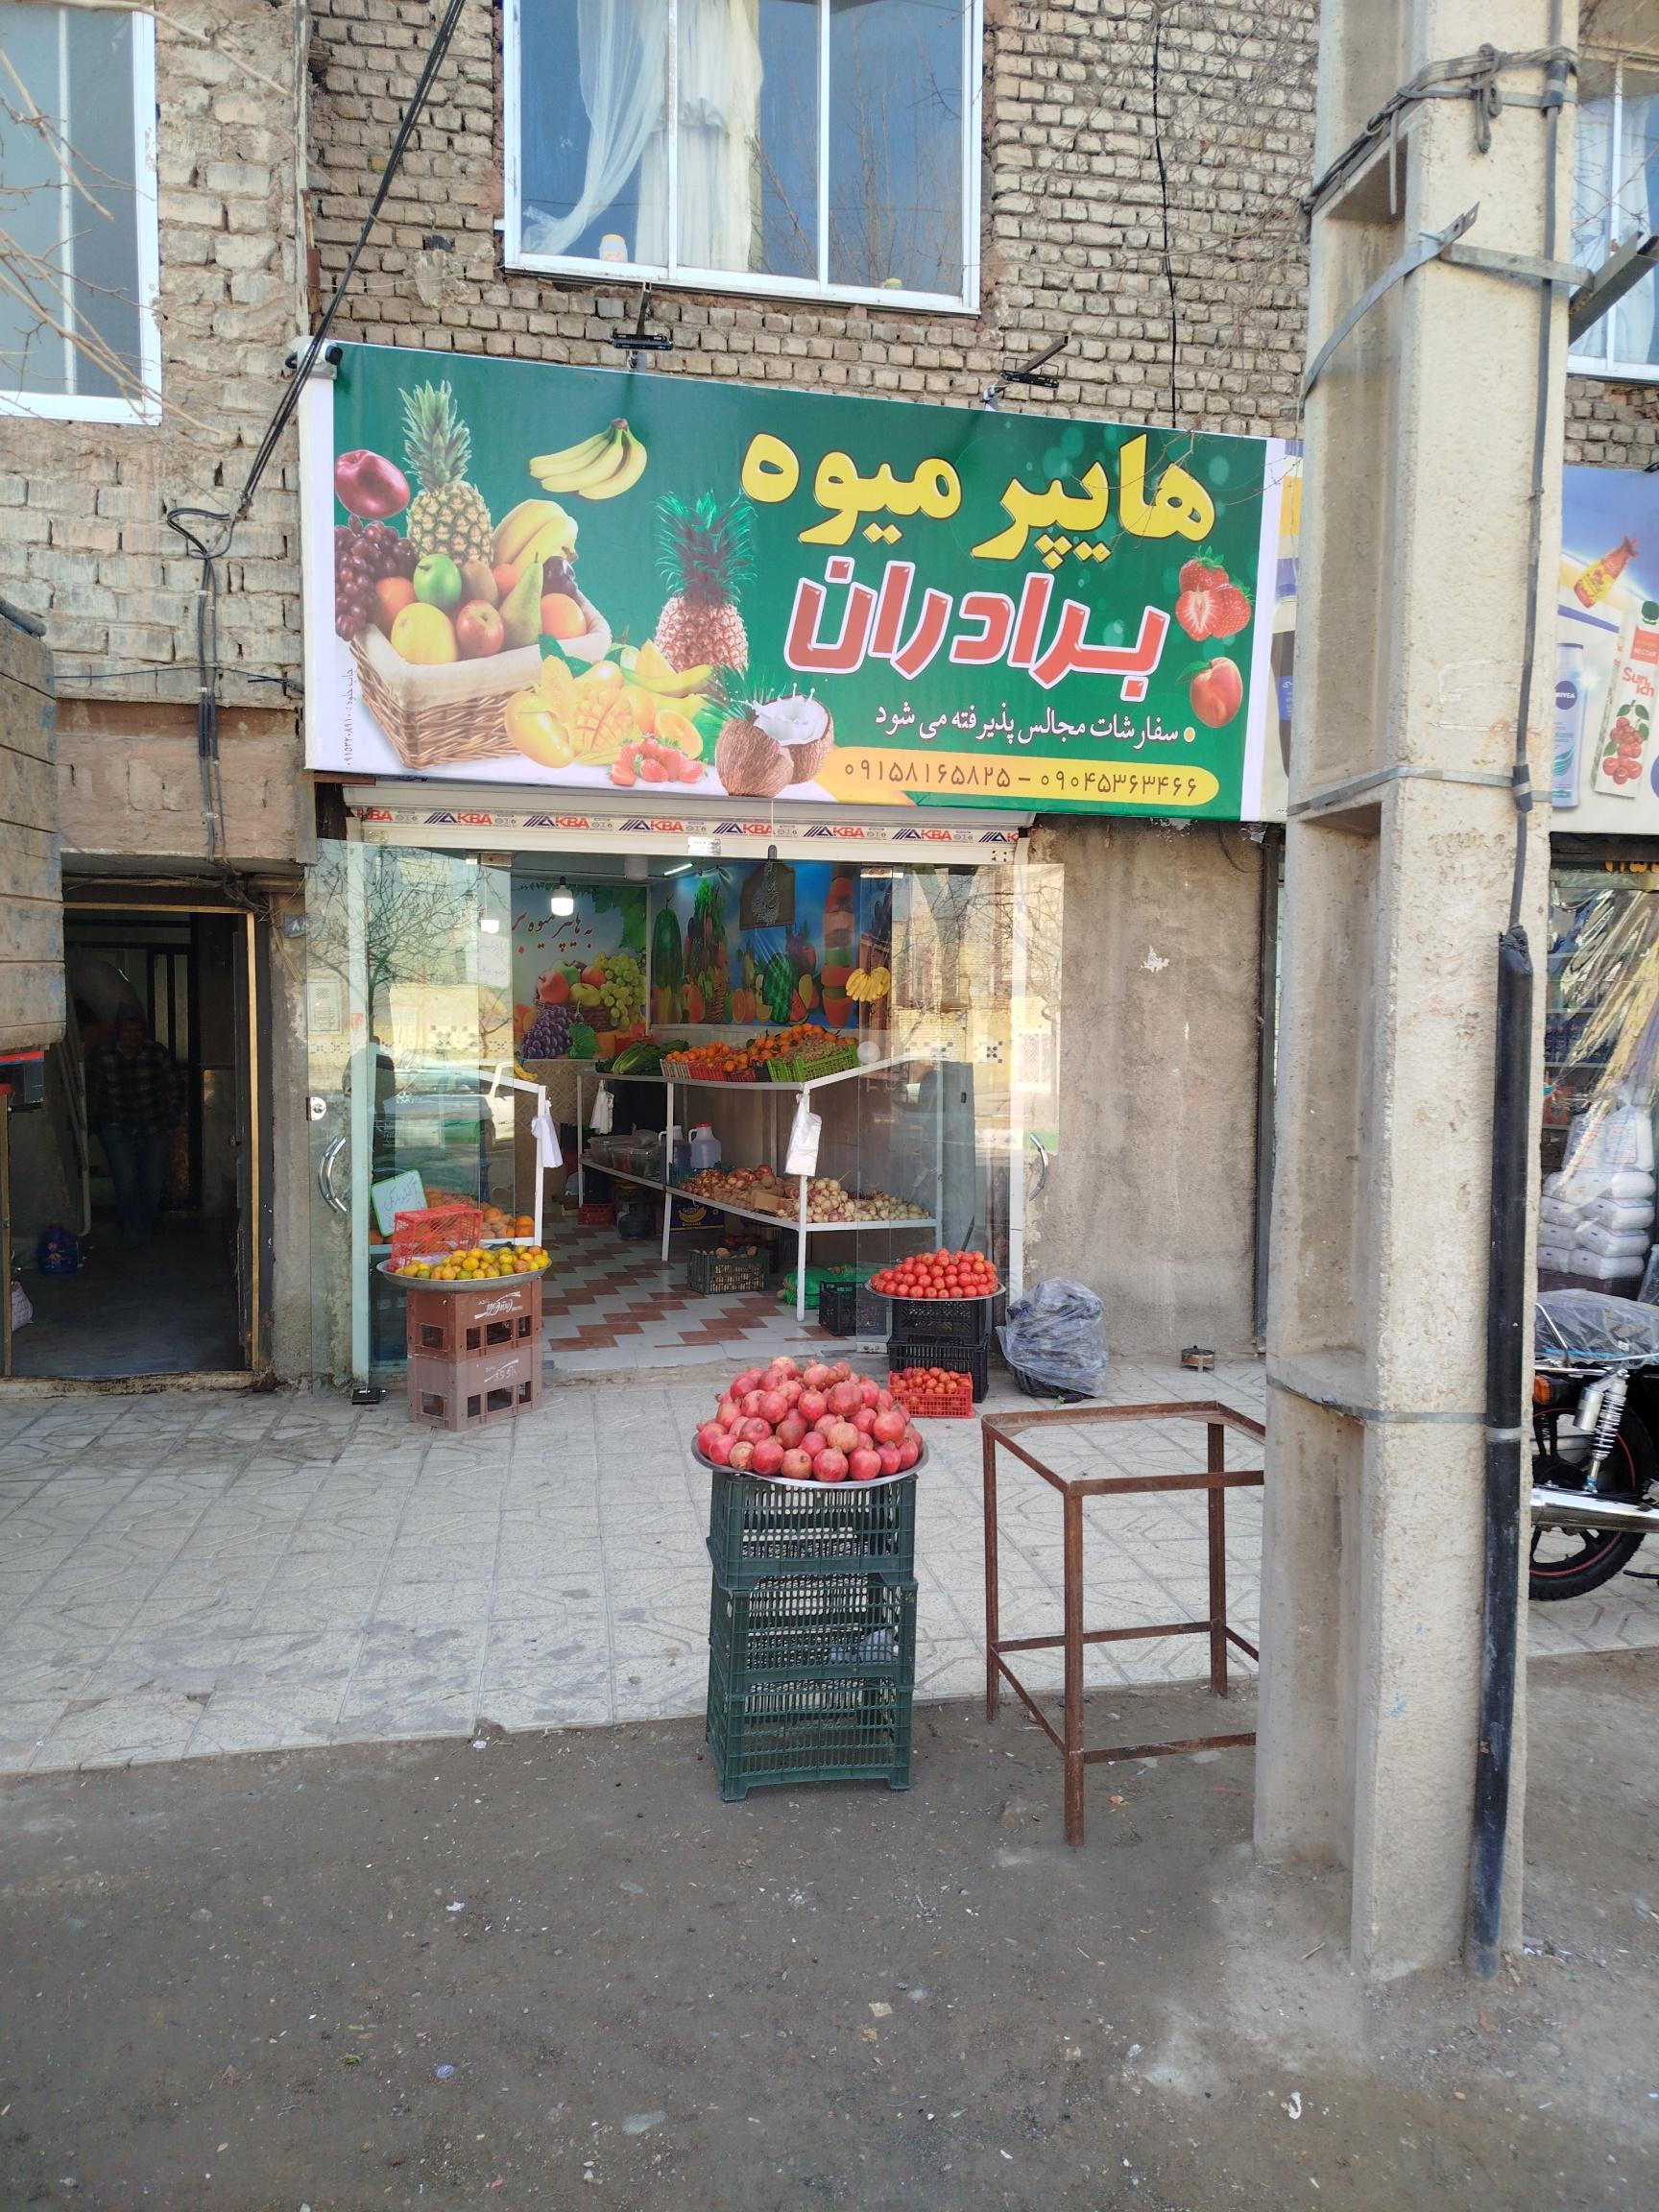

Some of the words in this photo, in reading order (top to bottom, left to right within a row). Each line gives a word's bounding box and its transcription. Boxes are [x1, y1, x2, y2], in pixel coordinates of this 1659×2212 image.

[741, 432, 962, 545] میوه
[971, 432, 1215, 569] هایپر
[783, 556, 1171, 702] برادران
[875, 701, 916, 735] شود
[919, 712, 948, 739] می
[951, 702, 1015, 744] پذیرفته
[1018, 706, 1087, 744] مجالس
[1090, 713, 1179, 750] سفارشات
